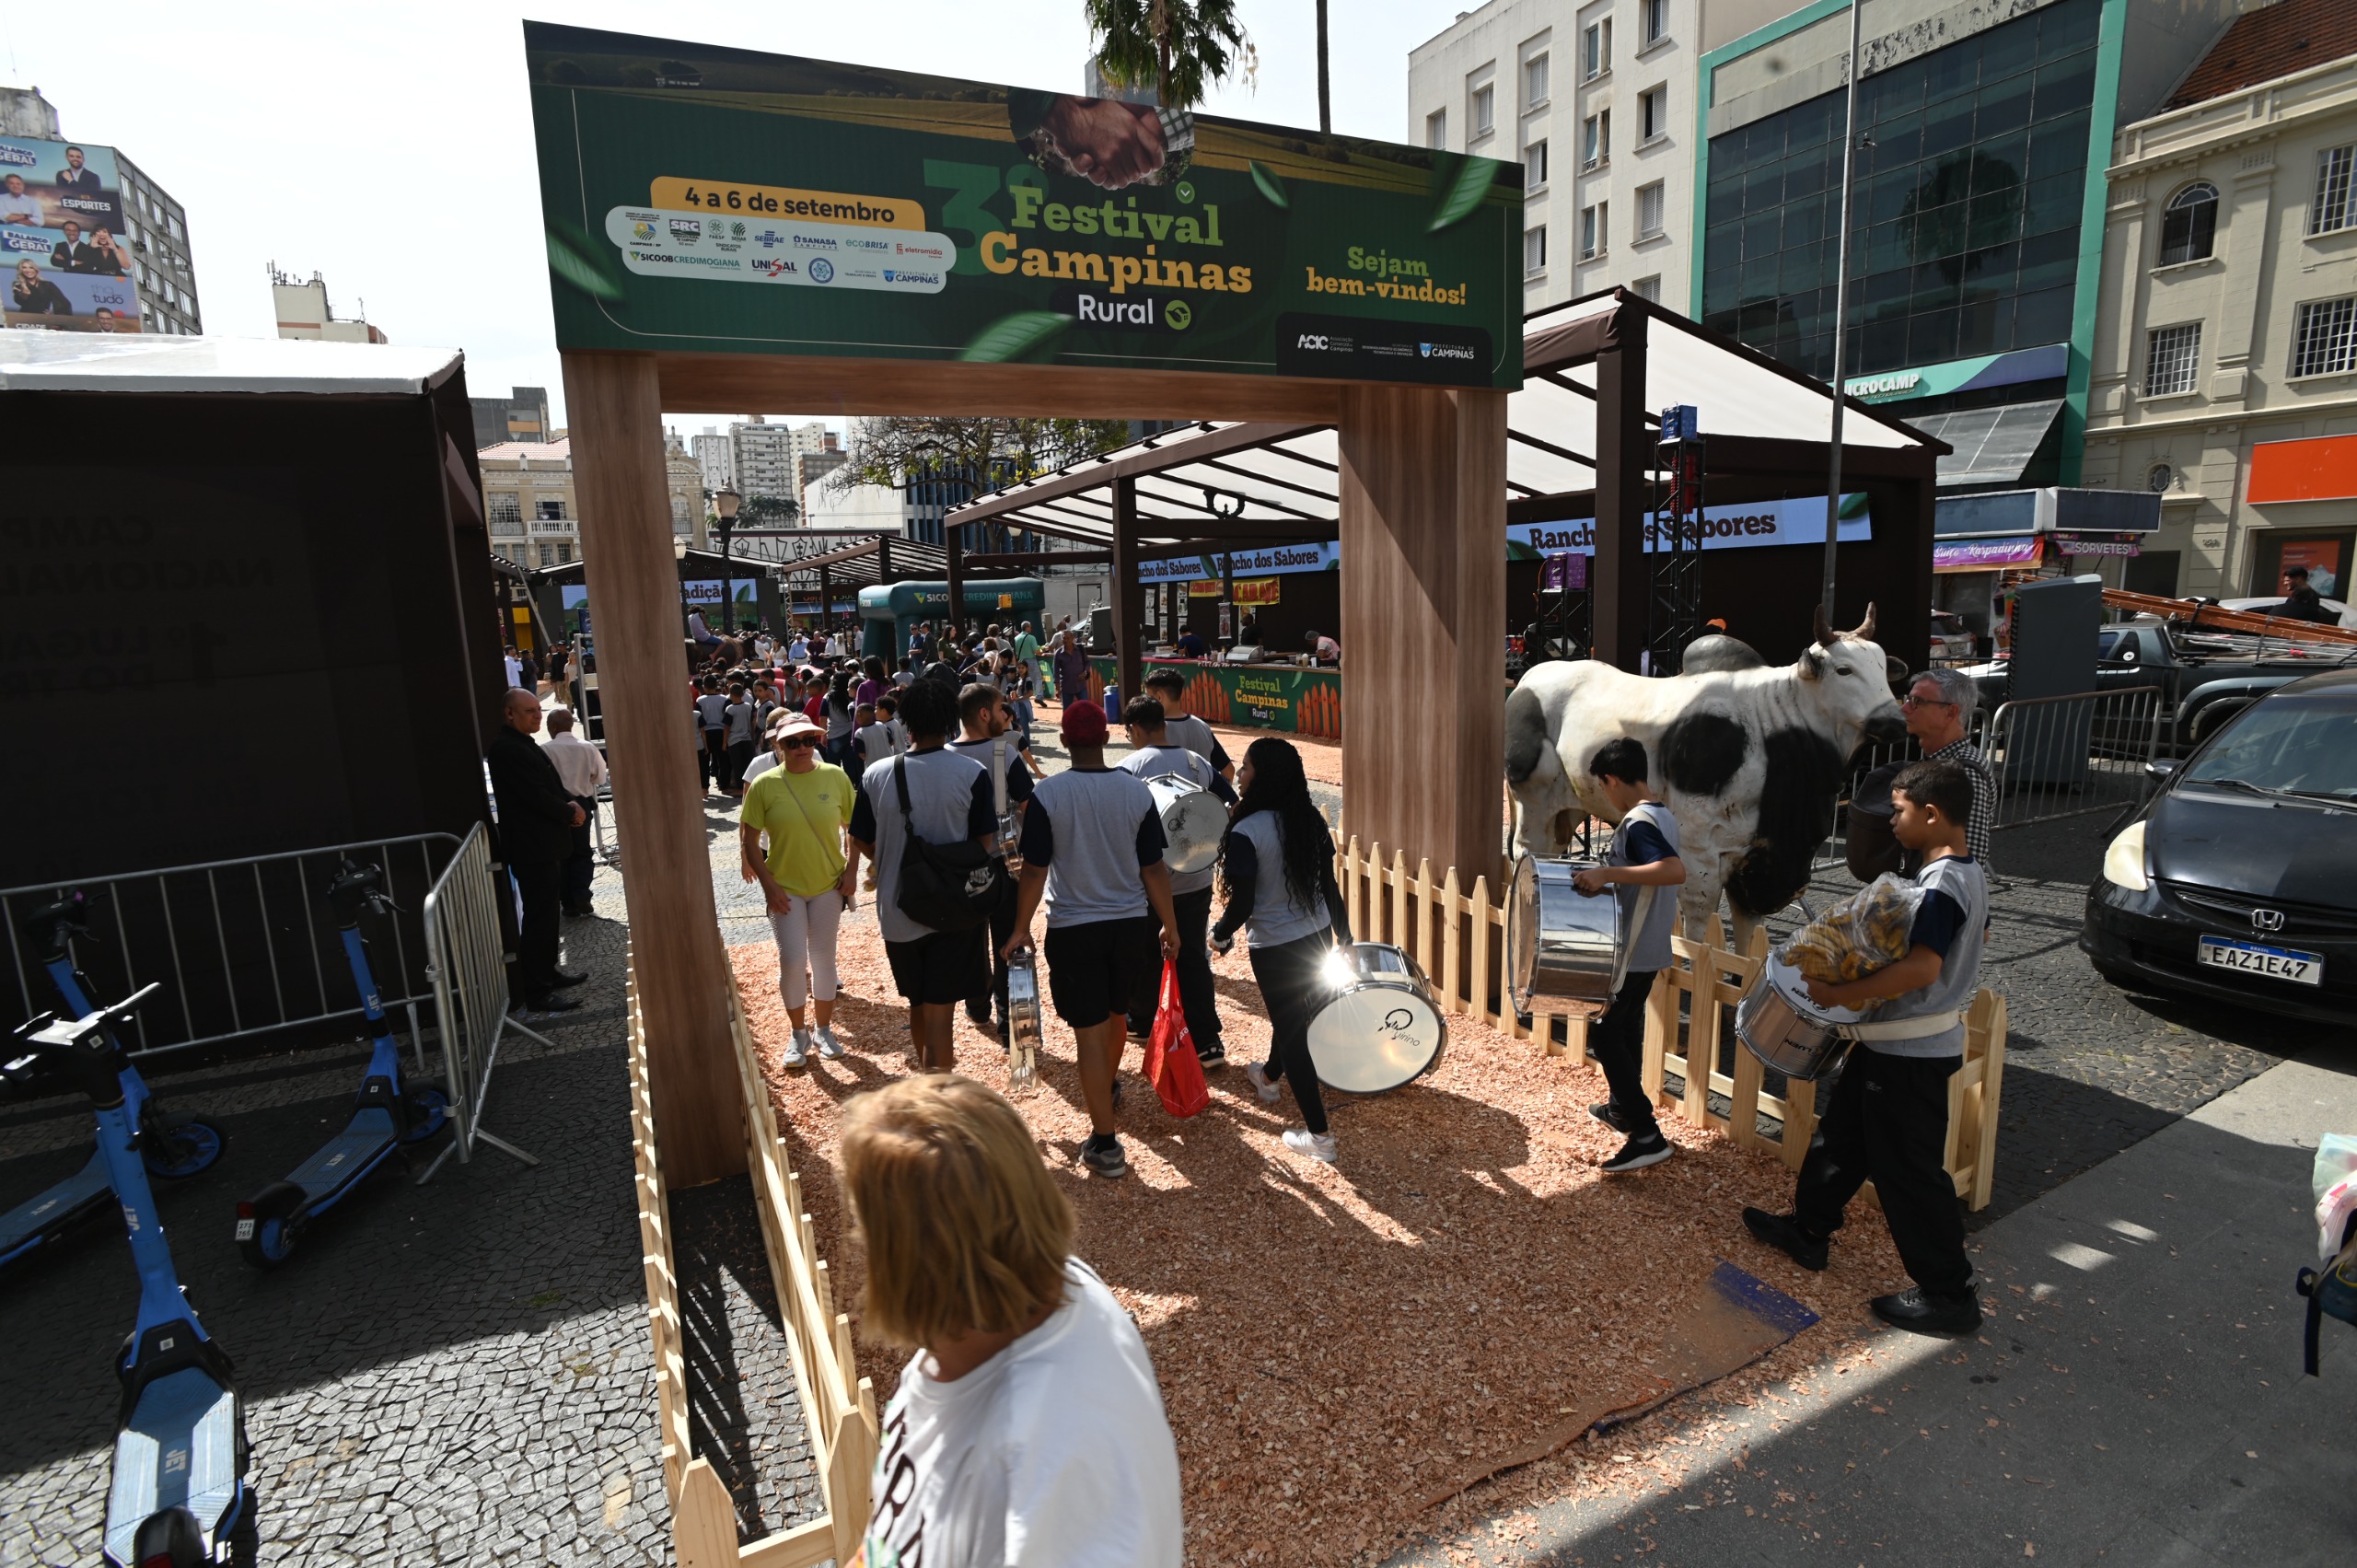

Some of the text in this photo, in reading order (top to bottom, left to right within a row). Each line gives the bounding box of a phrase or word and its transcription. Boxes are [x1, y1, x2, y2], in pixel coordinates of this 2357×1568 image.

[63, 198, 110, 211] ESPORTES
[685, 187, 895, 223] 4 a 6 de setembro
[1009, 185, 1224, 246] Festival
[670, 220, 699, 231] SRC
[8, 239, 51, 252] GERAL
[754, 235, 784, 243] SEBRAE
[802, 237, 837, 246] SANASA
[640, 253, 740, 267] SICOOB CREDIMOGIANA
[905, 247, 943, 256] eletromidia
[751, 258, 798, 275] UNISAL
[980, 231, 1252, 294] Campinas
[1347, 246, 1429, 278] Sejam
[896, 274, 939, 285] CAMPINAS
[1306, 266, 1466, 306] bem-vindos!
[93, 294, 124, 305] tudo
[1078, 294, 1154, 324] Rural
[1297, 334, 1329, 351] ACIC
[1432, 348, 1475, 359] CAMPINAS
[1664, 513, 1777, 541] Sabores
[1529, 523, 1596, 551] Ranch
[2074, 541, 2130, 555] SORVETES
[1155, 564, 1168, 576] dos
[1169, 560, 1201, 575] Sabores
[1217, 550, 1318, 571] Rncho dos Sabores
[927, 593, 948, 602] SICO
[1238, 675, 1281, 692] Festival
[1235, 689, 1289, 709] Campinas
[1252, 707, 1268, 719] Rural
[970, 866, 990, 884] NIKE
[2249, 946, 2270, 954] BRASIL
[2212, 947, 2309, 978] EAZ1E47
[366, 993, 380, 1012] JET
[325, 1153, 345, 1167] JET
[123, 1204, 141, 1231] JET
[165, 1448, 186, 1475] JET
